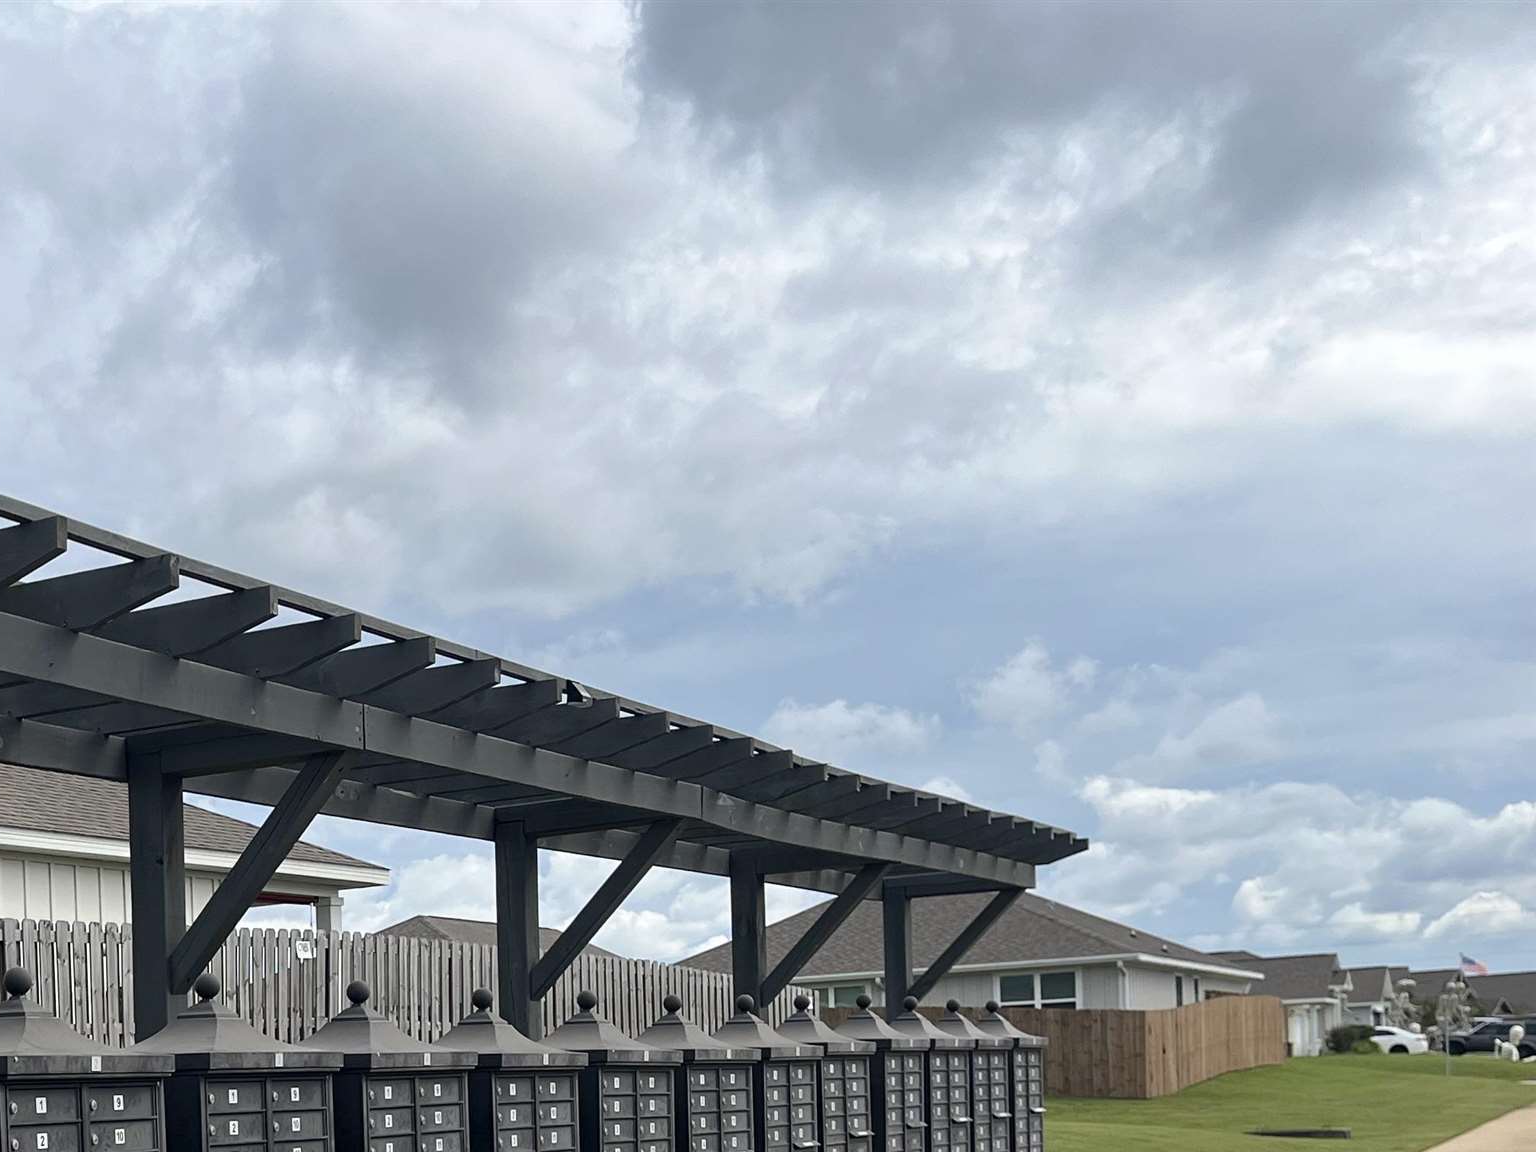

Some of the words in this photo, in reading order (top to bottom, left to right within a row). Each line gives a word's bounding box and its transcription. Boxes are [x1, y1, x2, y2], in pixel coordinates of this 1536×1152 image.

[39, 1099, 44, 1111] 1
[116, 1096, 122, 1108] 9
[40, 1135, 46, 1147] 2
[116, 1130, 124, 1142] 10
